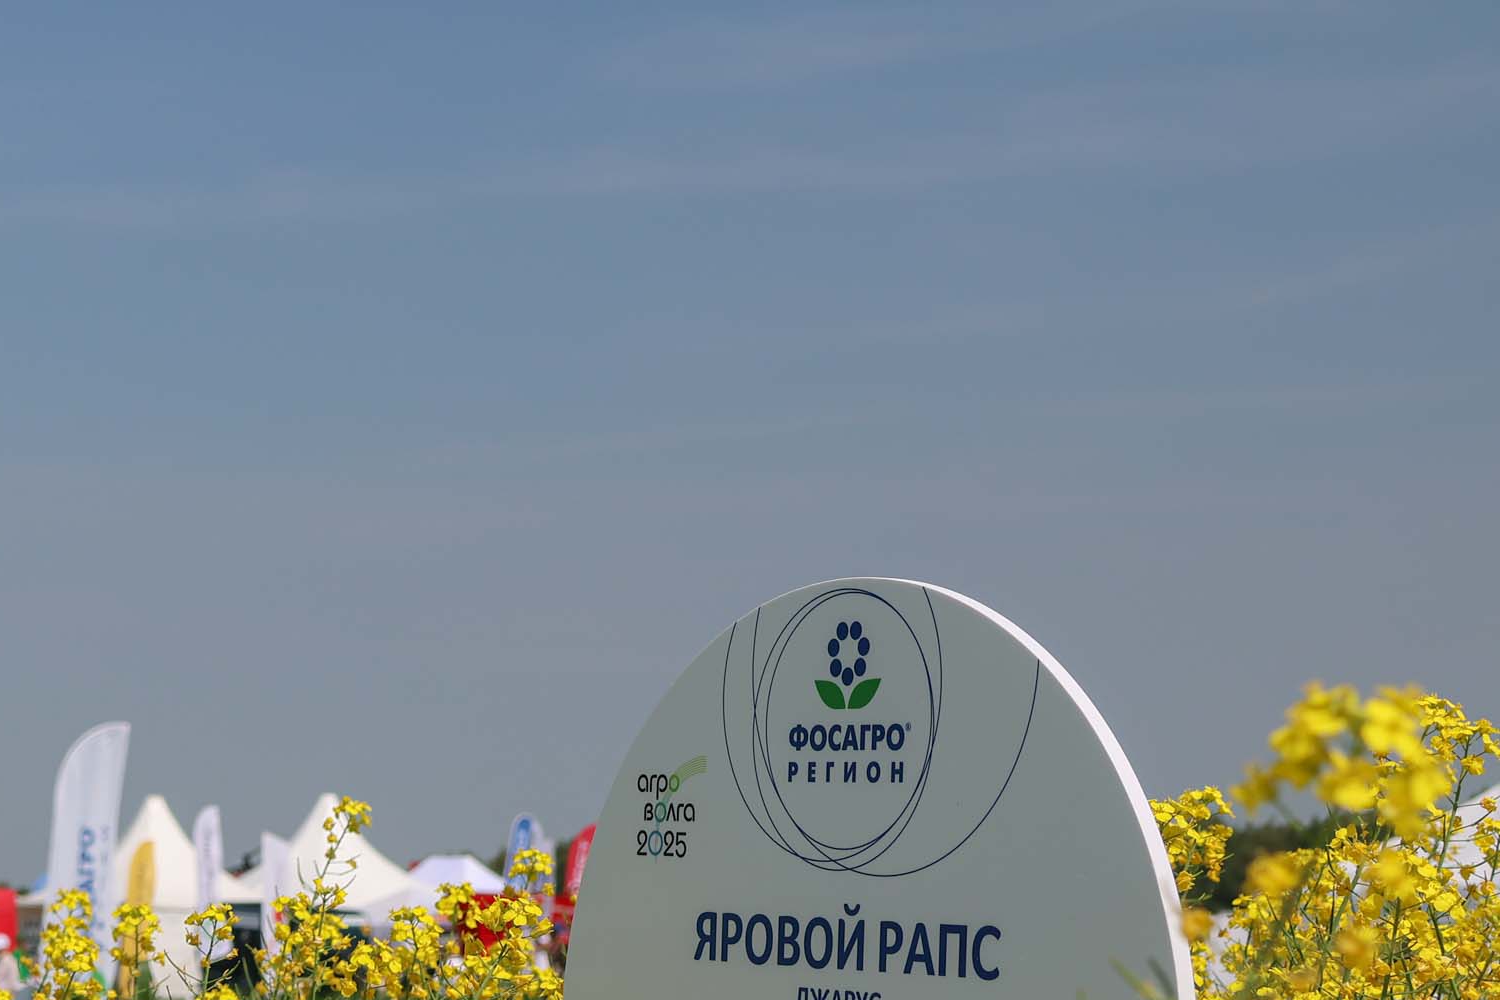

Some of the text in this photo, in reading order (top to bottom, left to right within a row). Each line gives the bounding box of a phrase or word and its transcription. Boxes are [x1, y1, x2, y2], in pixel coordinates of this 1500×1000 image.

[787, 761, 904, 783] РЕГИОН
[637, 773, 680, 800] агро
[643, 802, 696, 822] волга
[636, 830, 688, 858] 2025
[694, 903, 1002, 981] ЯРОВОЙ РАПС
